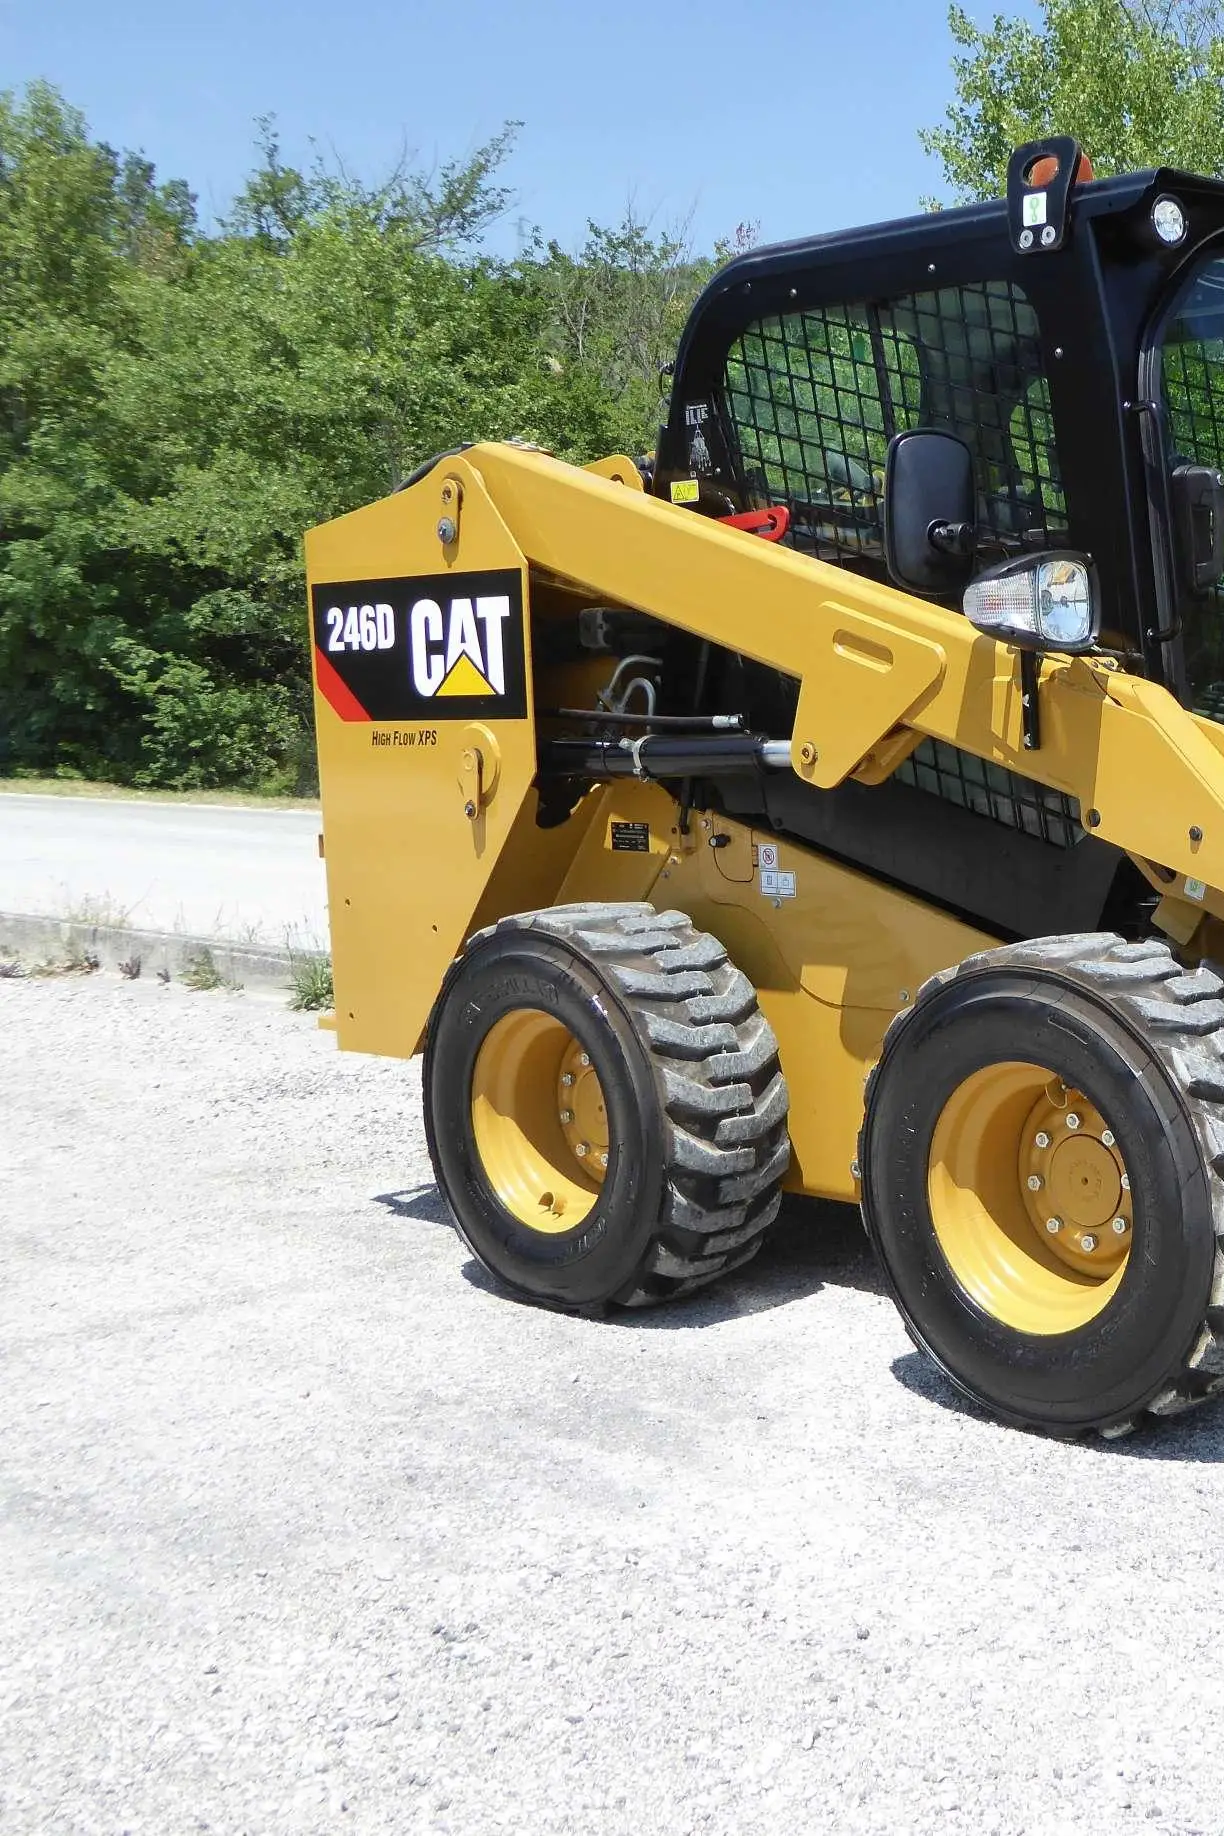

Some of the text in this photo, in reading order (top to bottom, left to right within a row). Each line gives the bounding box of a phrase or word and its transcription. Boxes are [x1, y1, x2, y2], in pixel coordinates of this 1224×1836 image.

[326, 595, 510, 697] 246D CAT
[417, 729, 437, 746] XPS
